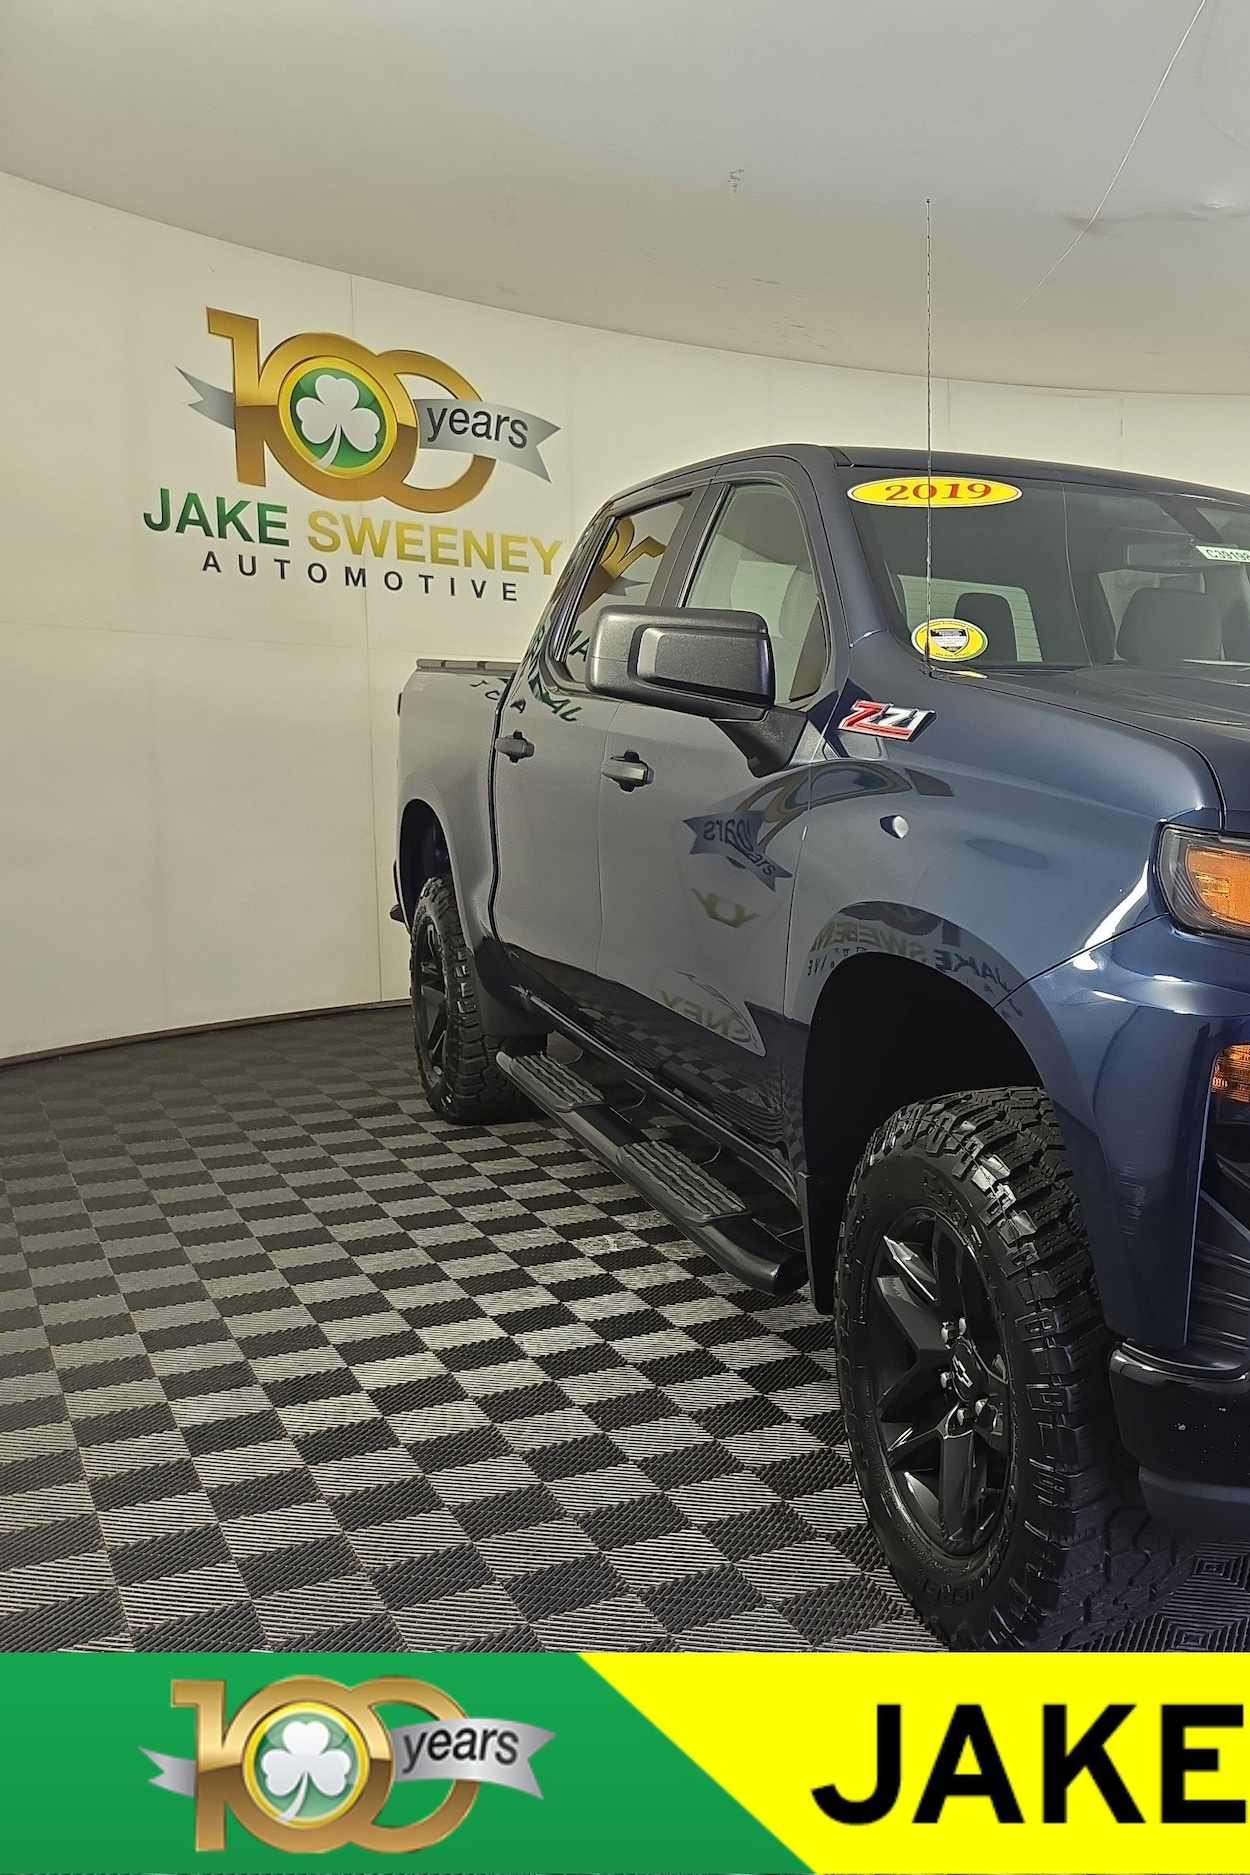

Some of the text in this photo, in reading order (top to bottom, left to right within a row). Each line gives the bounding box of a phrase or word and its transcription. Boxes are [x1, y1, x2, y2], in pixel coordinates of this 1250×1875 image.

[205, 306, 530, 514] 100 years
[884, 482, 993, 502] 2019
[143, 487, 564, 577] JAKE SWEENEY
[201, 550, 519, 602] AUTOMOTIVE
[838, 698, 937, 742] Z71
